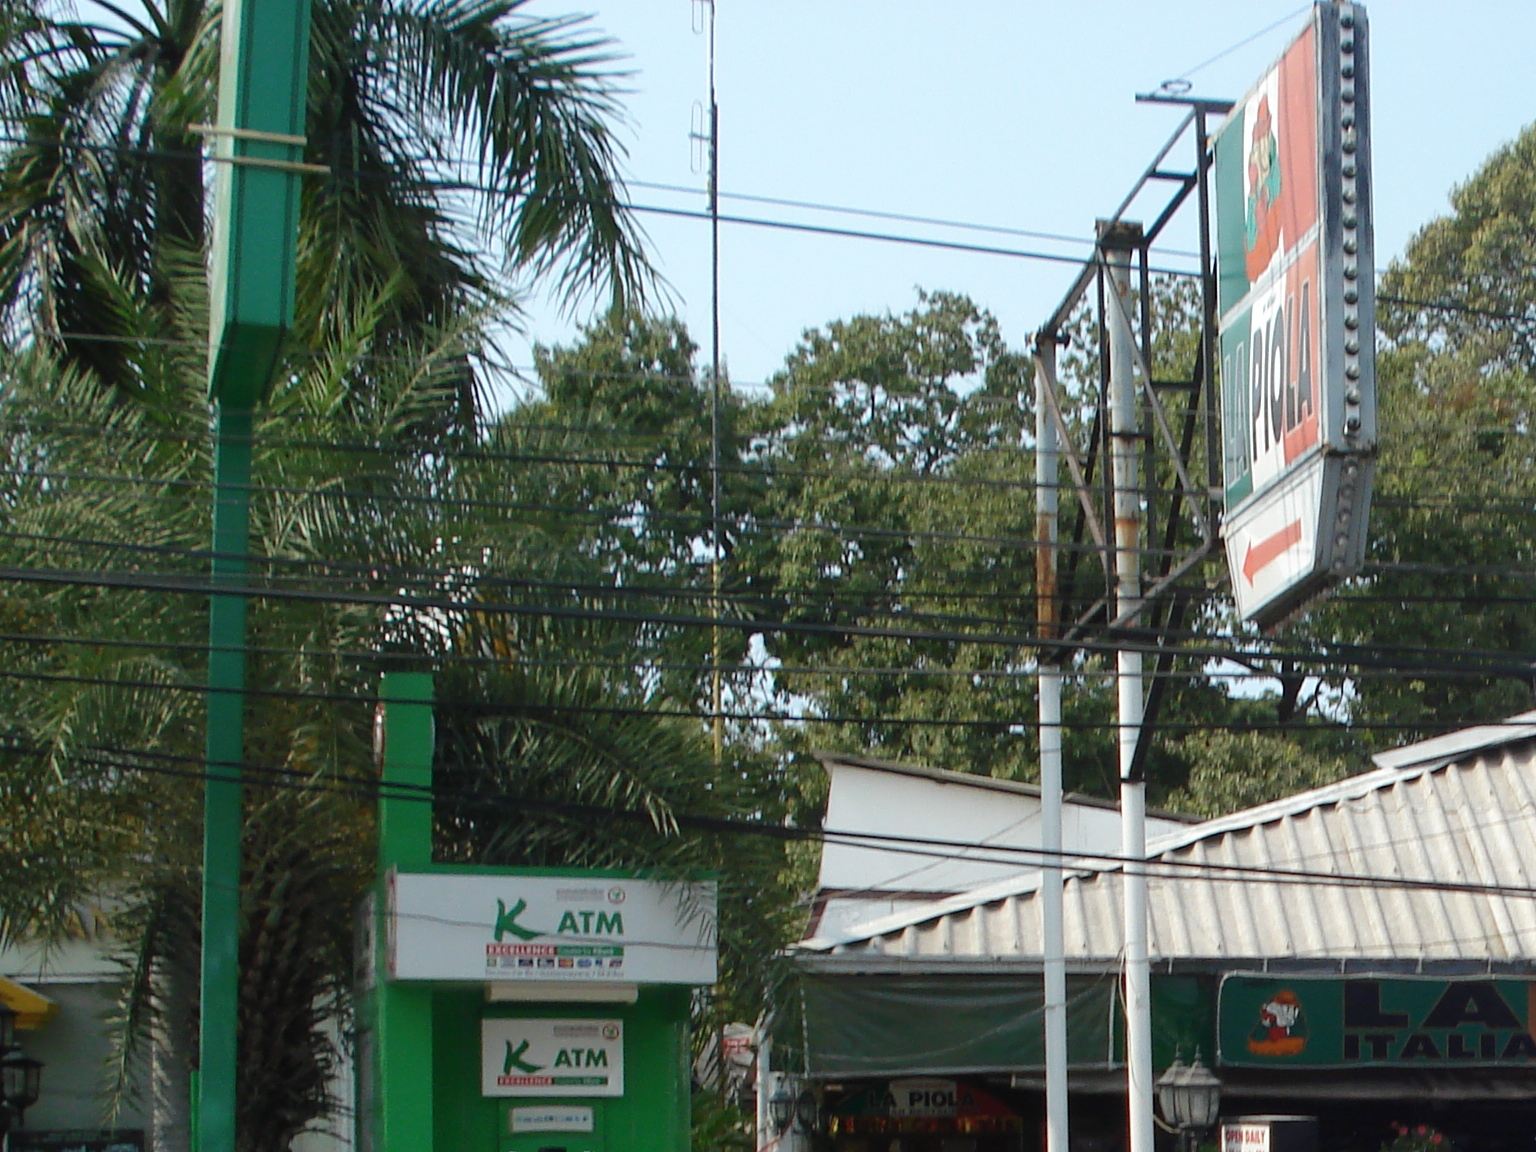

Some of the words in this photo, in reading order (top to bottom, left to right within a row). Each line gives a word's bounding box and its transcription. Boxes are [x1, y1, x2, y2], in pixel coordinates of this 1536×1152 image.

[1224, 340, 1249, 488] LA
[1250, 276, 1315, 464] PIOLA
[557, 911, 624, 935] ATM
[1344, 981, 1524, 1029] LA
[555, 1048, 608, 1067] ATM
[869, 1091, 897, 1107] LA
[909, 1090, 975, 1107] PIOLA
